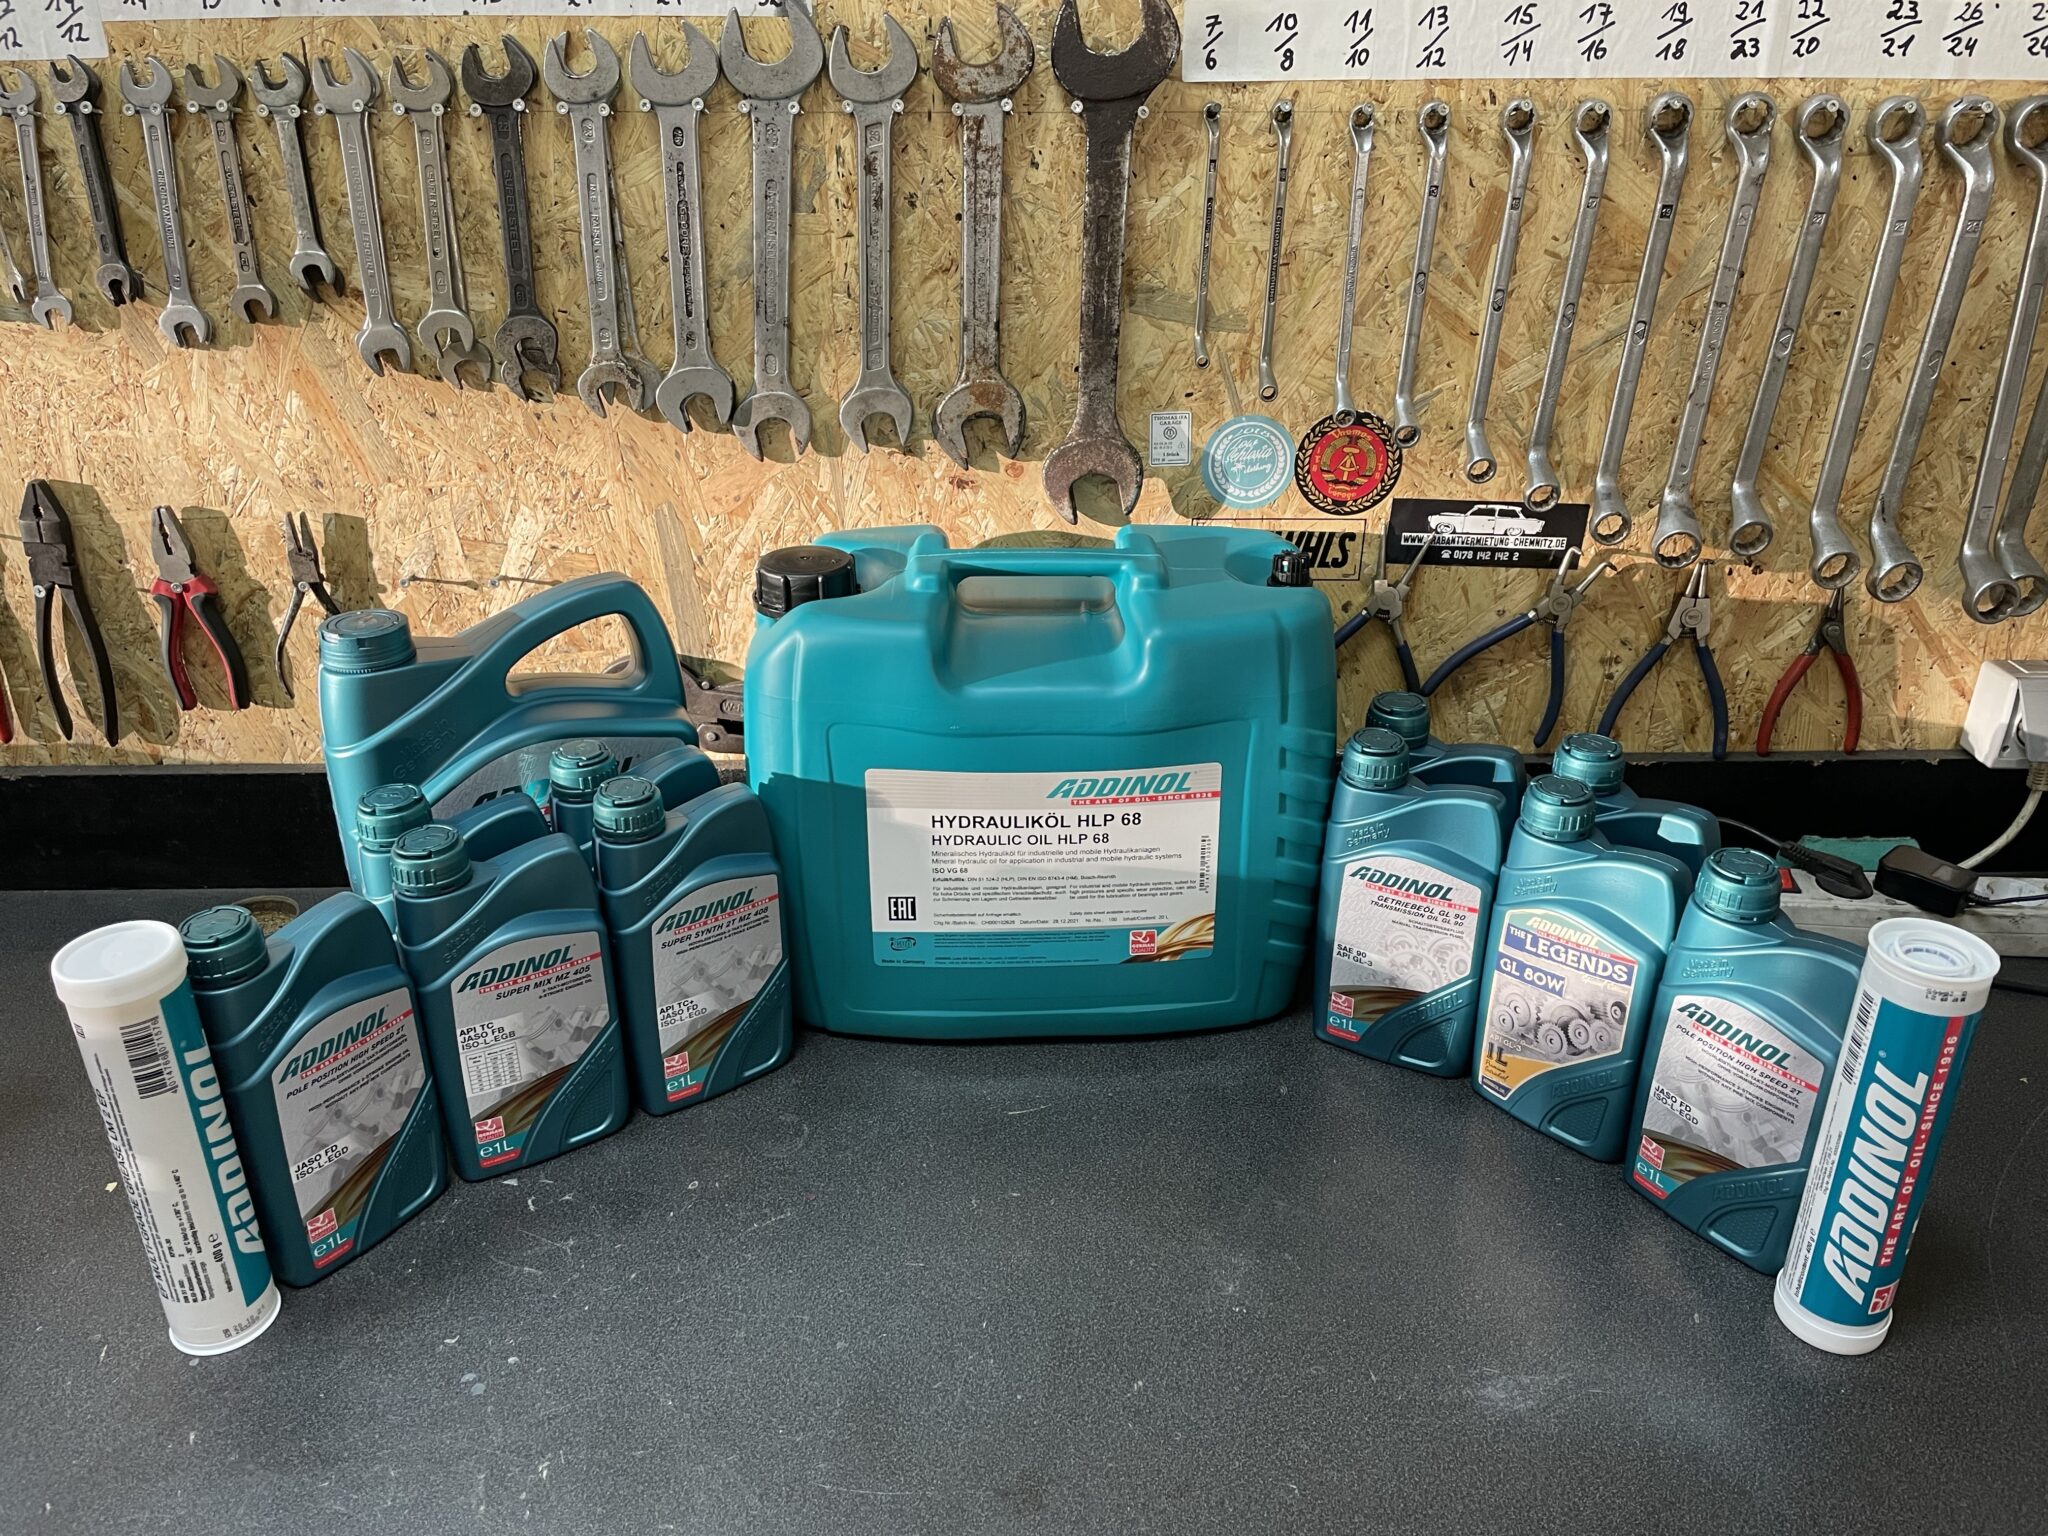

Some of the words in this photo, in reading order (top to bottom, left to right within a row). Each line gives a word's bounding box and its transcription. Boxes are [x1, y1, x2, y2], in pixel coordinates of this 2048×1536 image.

[1418, 6, 1448, 29] 13
[1505, 4, 1537, 25] 15
[1580, 3, 1613, 25] 17
[1661, 2, 1689, 21] 19
[1736, 0, 1763, 20] 21
[1798, 0, 1825, 19] 22
[1887, 0, 1918, 20] 23
[1954, 2, 1982, 21] 26
[61, 22, 90, 42] 12
[1206, 15, 1222, 36] 7
[1265, 13, 1297, 32] 10
[1344, 9, 1372, 33] 11
[1504, 40, 1533, 66] 14
[1581, 39, 1607, 61] 16
[1656, 39, 1687, 60] 18
[1731, 38, 1759, 59] 23
[1793, 37, 1820, 57] 20
[1883, 35, 1915, 57] 21
[1948, 37, 1977, 57] 24
[1206, 49, 1216, 70] 6
[1281, 48, 1293, 71] 8
[1345, 49, 1369, 67] 10
[1416, 48, 1445, 68] 12
[1453, 551, 1473, 560] 0178
[1477, 552, 1491, 560] 142
[1494, 552, 1509, 561] 142
[1513, 553, 1520, 561] 2
[1046, 772, 1191, 799] ADDINOL
[931, 812, 1071, 829] HYDRAULIKÖL
[1077, 814, 1115, 828] HLP
[1121, 812, 1142, 826] 68
[932, 835, 1022, 846] HYDRAULIC
[1027, 834, 1053, 845] OIL
[1058, 833, 1088, 845] HLP
[1092, 833, 1109, 844] 68
[1086, 855, 1099, 863] and
[1349, 866, 1453, 902] ADDINOL
[656, 888, 755, 935] ADDINOL
[1369, 899, 1425, 918] TRANSMISSION
[1426, 913, 1439, 921] OIL
[1376, 894, 1435, 914] GETRIEBEÖL
[1437, 909, 1451, 918] GL
[1452, 912, 1467, 921] 90
[661, 933, 691, 949] SUPER
[694, 922, 723, 938] SYNTH
[725, 917, 737, 927] 2T
[738, 912, 752, 923] MZ
[753, 905, 768, 917] 408
[1526, 916, 1601, 950] ADDINOL
[1335, 950, 1351, 960] API
[1351, 954, 1374, 966] GL-3
[1336, 942, 1354, 954] SAE
[1355, 949, 1367, 958] 90
[1509, 926, 1527, 939] THE
[1525, 930, 1628, 982] LEGENDS
[457, 946, 573, 994] ADDINOL
[1500, 958, 1520, 976] GL
[1524, 968, 1565, 994] 80W
[495, 983, 529, 1001] SUPER
[533, 976, 551, 989] MIX
[554, 971, 570, 982] MZ
[572, 964, 590, 976] 405
[659, 1003, 674, 1014] API
[660, 1007, 683, 1021] JASO
[686, 1003, 698, 1012] FD
[660, 1006, 707, 1028] ISO-L-EGD
[459, 1025, 476, 1037] API
[480, 1020, 493, 1031] TC
[460, 1030, 487, 1045] JASO
[491, 1025, 504, 1036] FB
[1677, 1002, 1789, 1070] ADDINOL
[279, 1006, 388, 1085] ADDINOL
[460, 1028, 516, 1052] ISO-L-EGB
[286, 1081, 308, 1100] POLE
[310, 1058, 348, 1086] POSITION
[349, 1046, 368, 1063] HIGH
[369, 1031, 394, 1051] SPEED
[1676, 1024, 1695, 1040] POLE
[1696, 1037, 1736, 1062] POSITION
[1736, 1057, 1758, 1075] HIGH
[1758, 1070, 1789, 1091] SPEED
[1789, 1087, 1803, 1096] 2T
[1653, 1091, 1699, 1126] ISO-L-EGD
[1654, 1085, 1678, 1104] JASO
[1679, 1100, 1692, 1113] FD
[184, 1029, 267, 1254] ADDINOL
[1879, 1235, 1898, 1266] THE
[1889, 1201, 1908, 1231] ART
[1900, 1174, 1916, 1195] OF
[1919, 1078, 1944, 1130] SINCE
[1935, 1033, 1958, 1075] 1936
[293, 1152, 322, 1174] JASO
[324, 1143, 338, 1156] FD
[293, 1145, 350, 1181] ISO-L-EGD
[1824, 1061, 1929, 1305] ADDINOL
